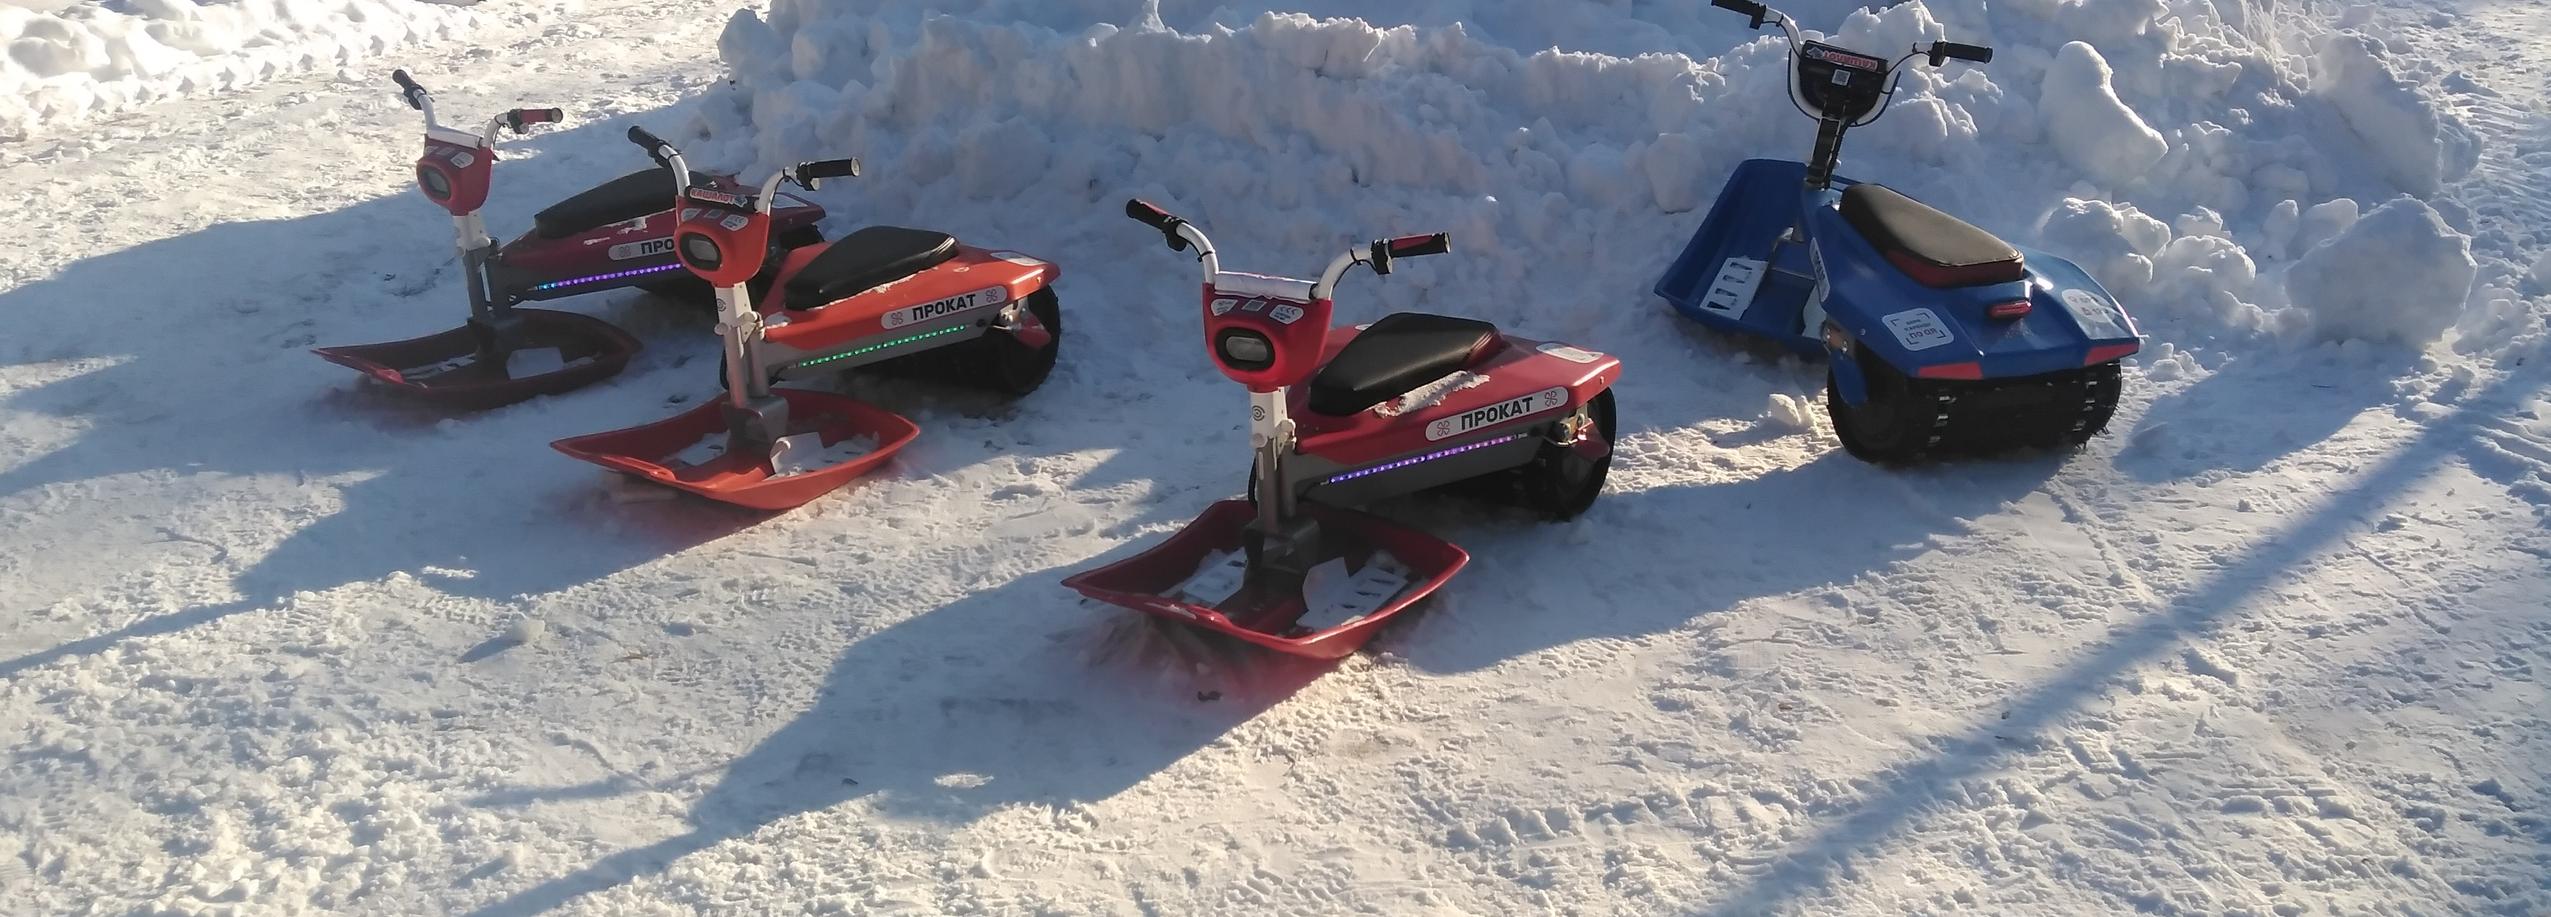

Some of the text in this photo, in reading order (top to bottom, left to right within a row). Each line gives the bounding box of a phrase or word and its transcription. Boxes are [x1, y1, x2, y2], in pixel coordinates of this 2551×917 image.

[690, 188, 736, 204] КАШАЛОТ
[641, 239, 674, 254] ПРО
[912, 294, 976, 320] ПРОКАТ
[1461, 397, 1533, 430] ПРОКАТ
